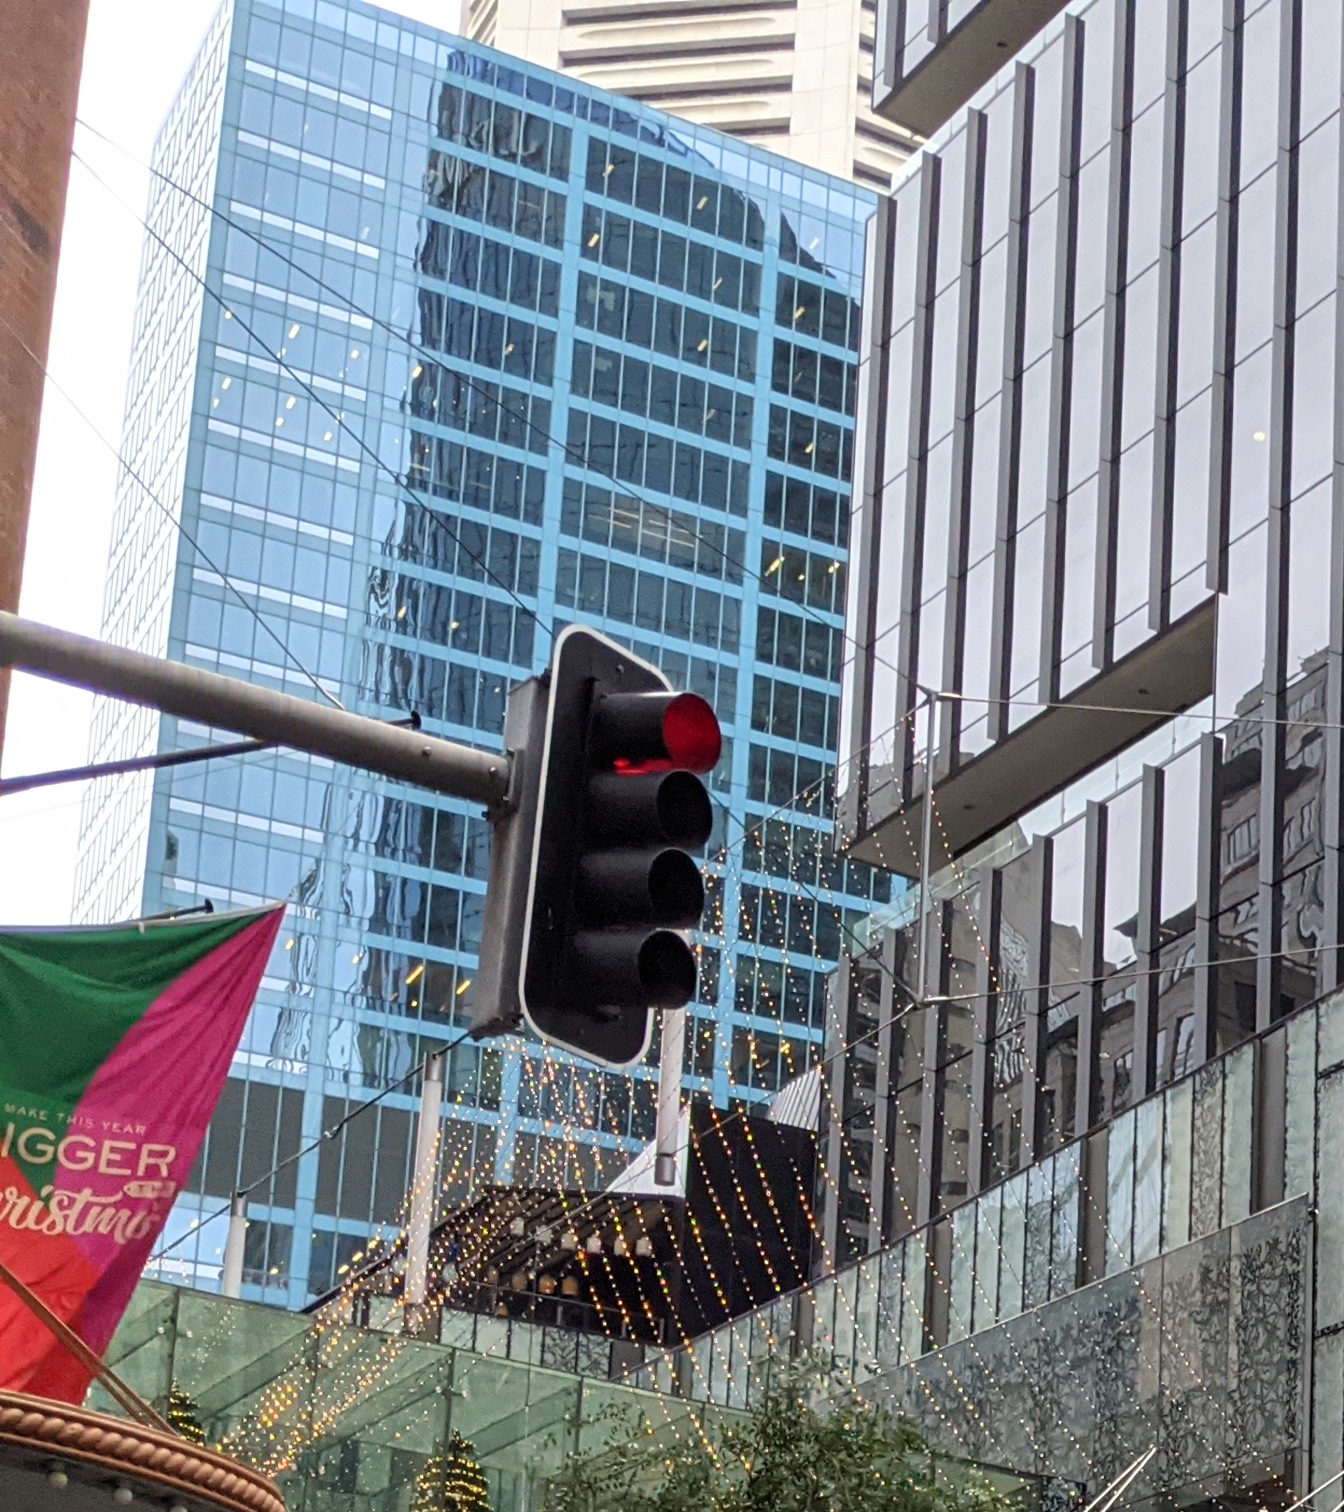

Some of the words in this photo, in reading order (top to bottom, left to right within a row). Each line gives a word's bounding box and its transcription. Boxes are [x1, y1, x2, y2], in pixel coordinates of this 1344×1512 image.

[4, 1103, 48, 1121] MAKE
[56, 1113, 95, 1129] THIS
[102, 1121, 147, 1136] YEAR
[0, 1121, 177, 1178] IGGER
